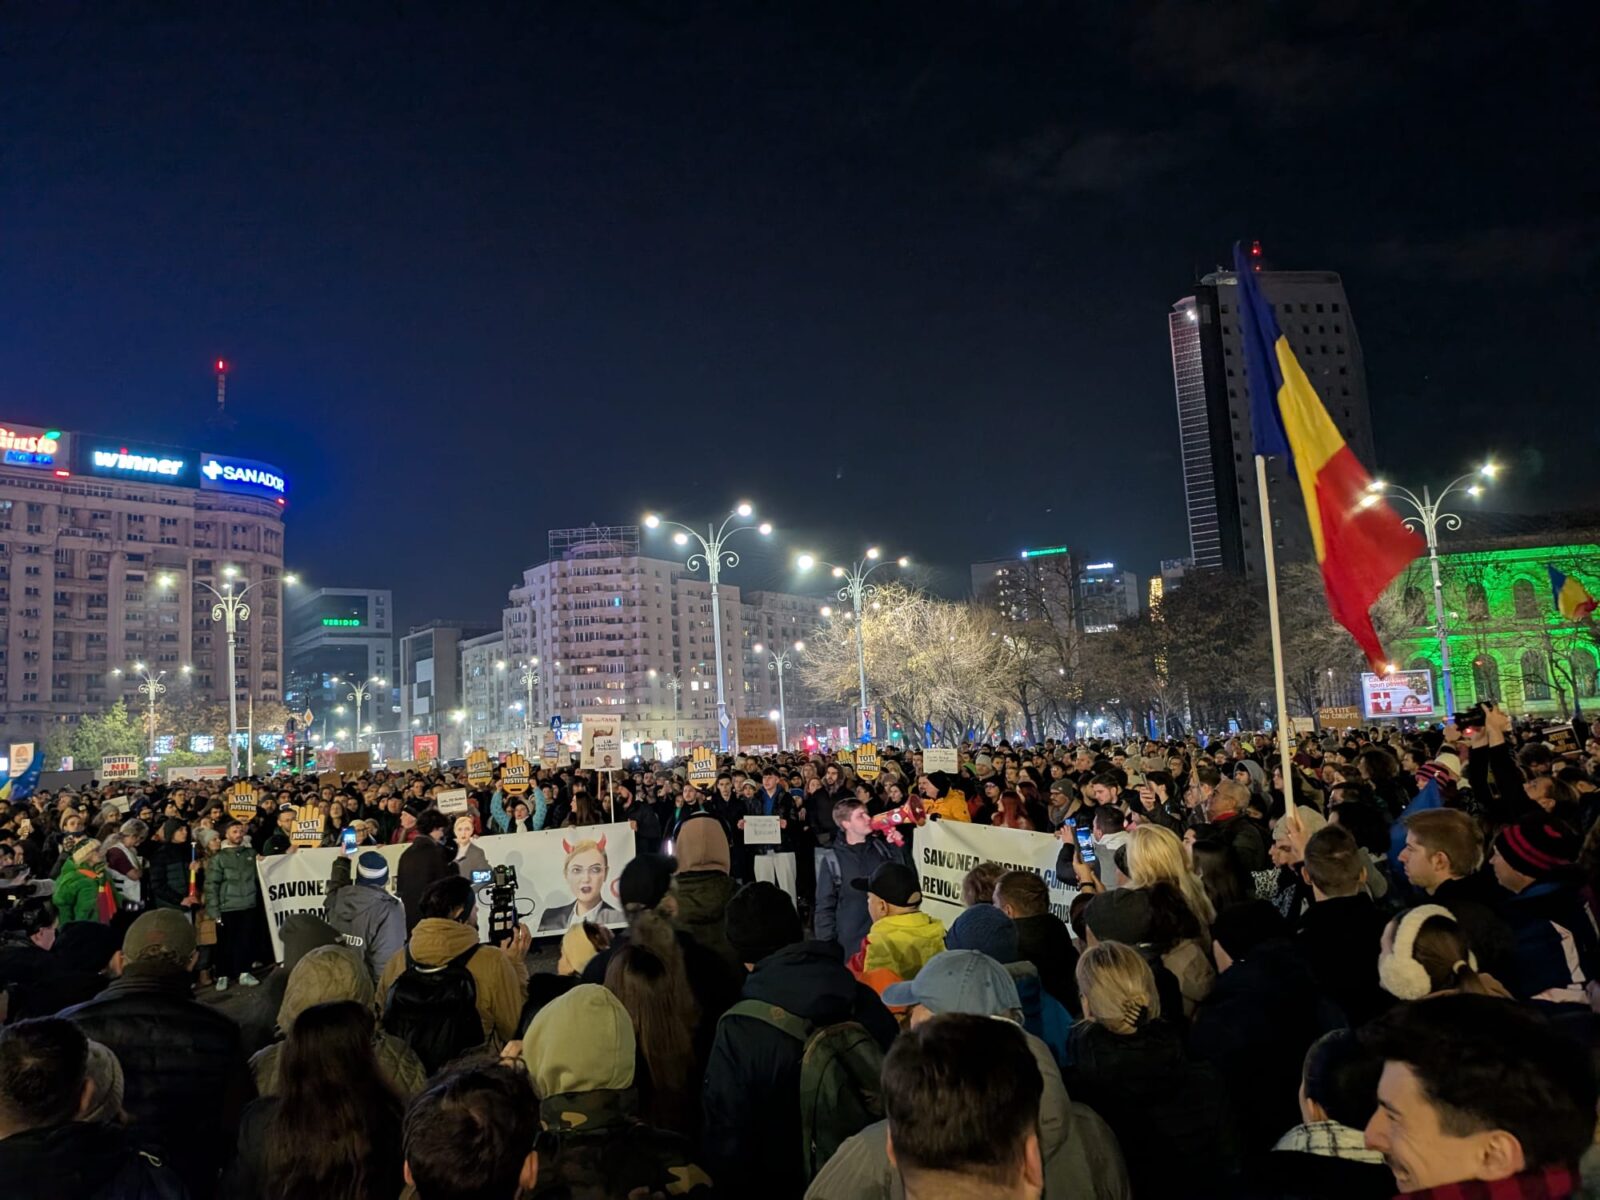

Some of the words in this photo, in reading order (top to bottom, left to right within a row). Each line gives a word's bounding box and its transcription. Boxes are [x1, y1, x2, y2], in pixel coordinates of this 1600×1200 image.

[94, 448, 183, 475] winner
[223, 465, 285, 492] SANADOR
[268, 879, 329, 901] SAVONE
[922, 875, 961, 900] REVOC
